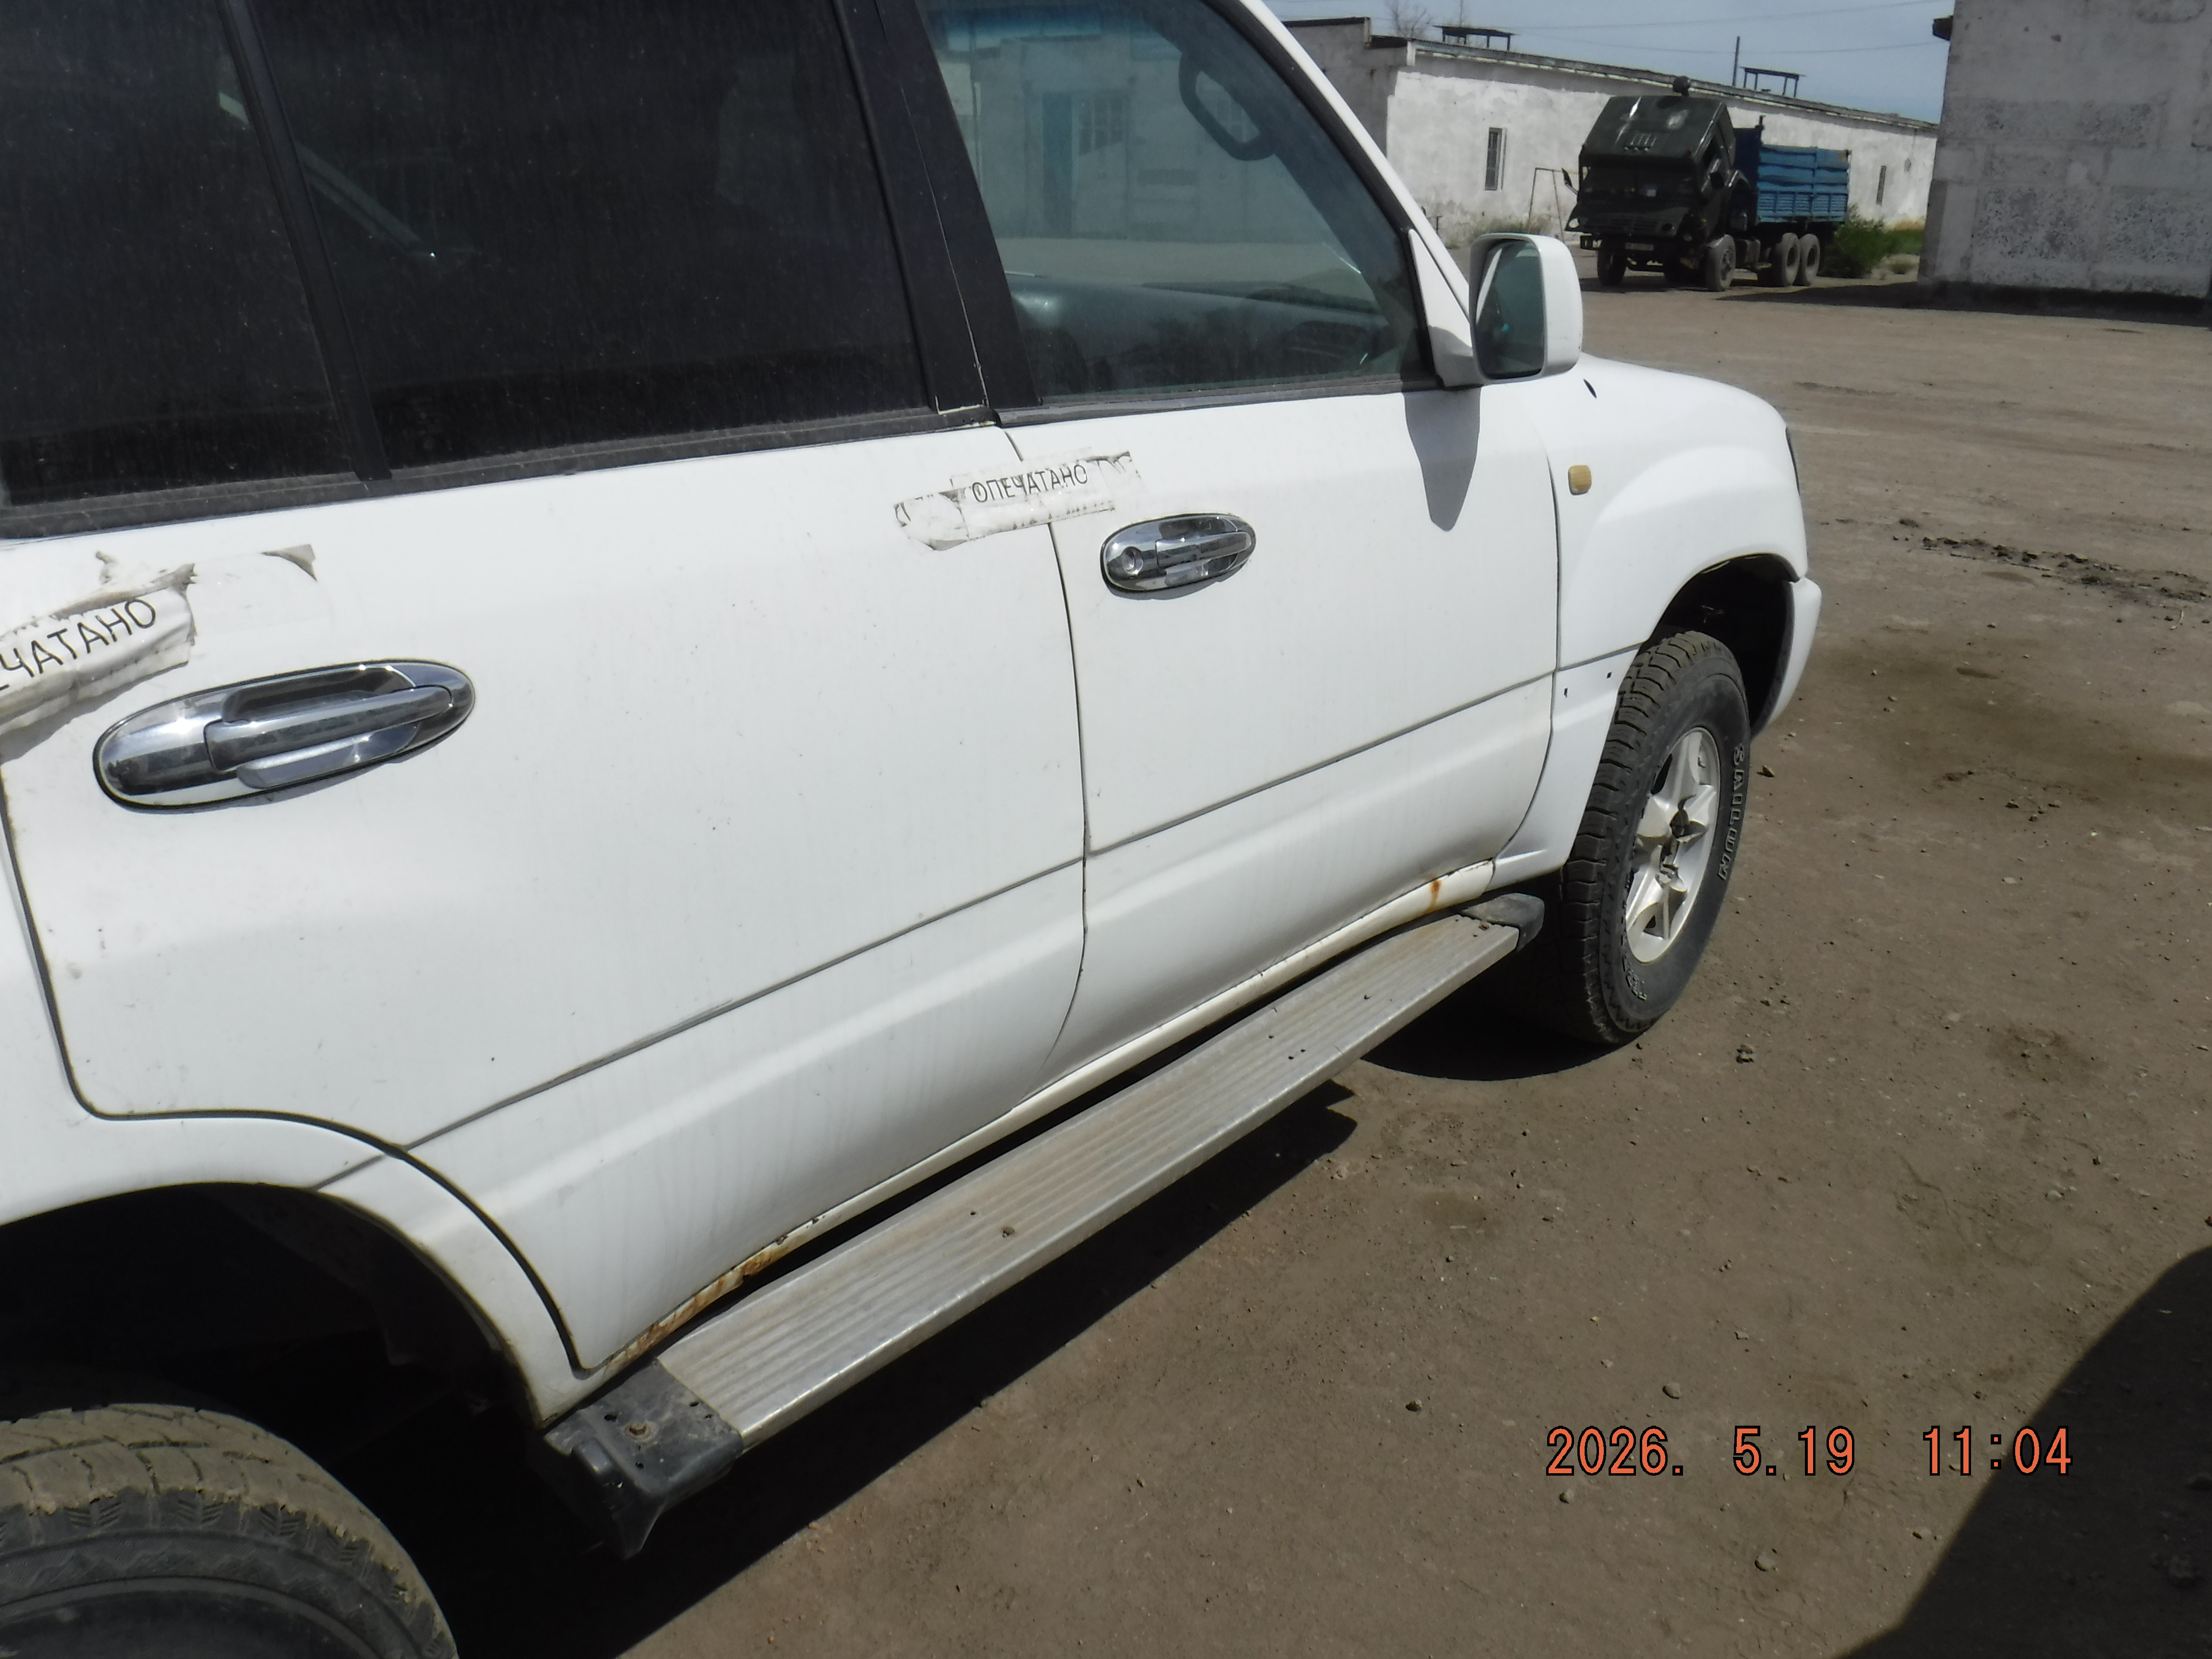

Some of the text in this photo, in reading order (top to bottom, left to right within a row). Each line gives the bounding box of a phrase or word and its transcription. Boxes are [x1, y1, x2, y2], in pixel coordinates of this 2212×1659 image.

[972, 464, 1088, 503] ОПЕЧАТАНО
[0, 598, 156, 691] ЧАТАНО
[1718, 743, 1745, 880] SAILUN
